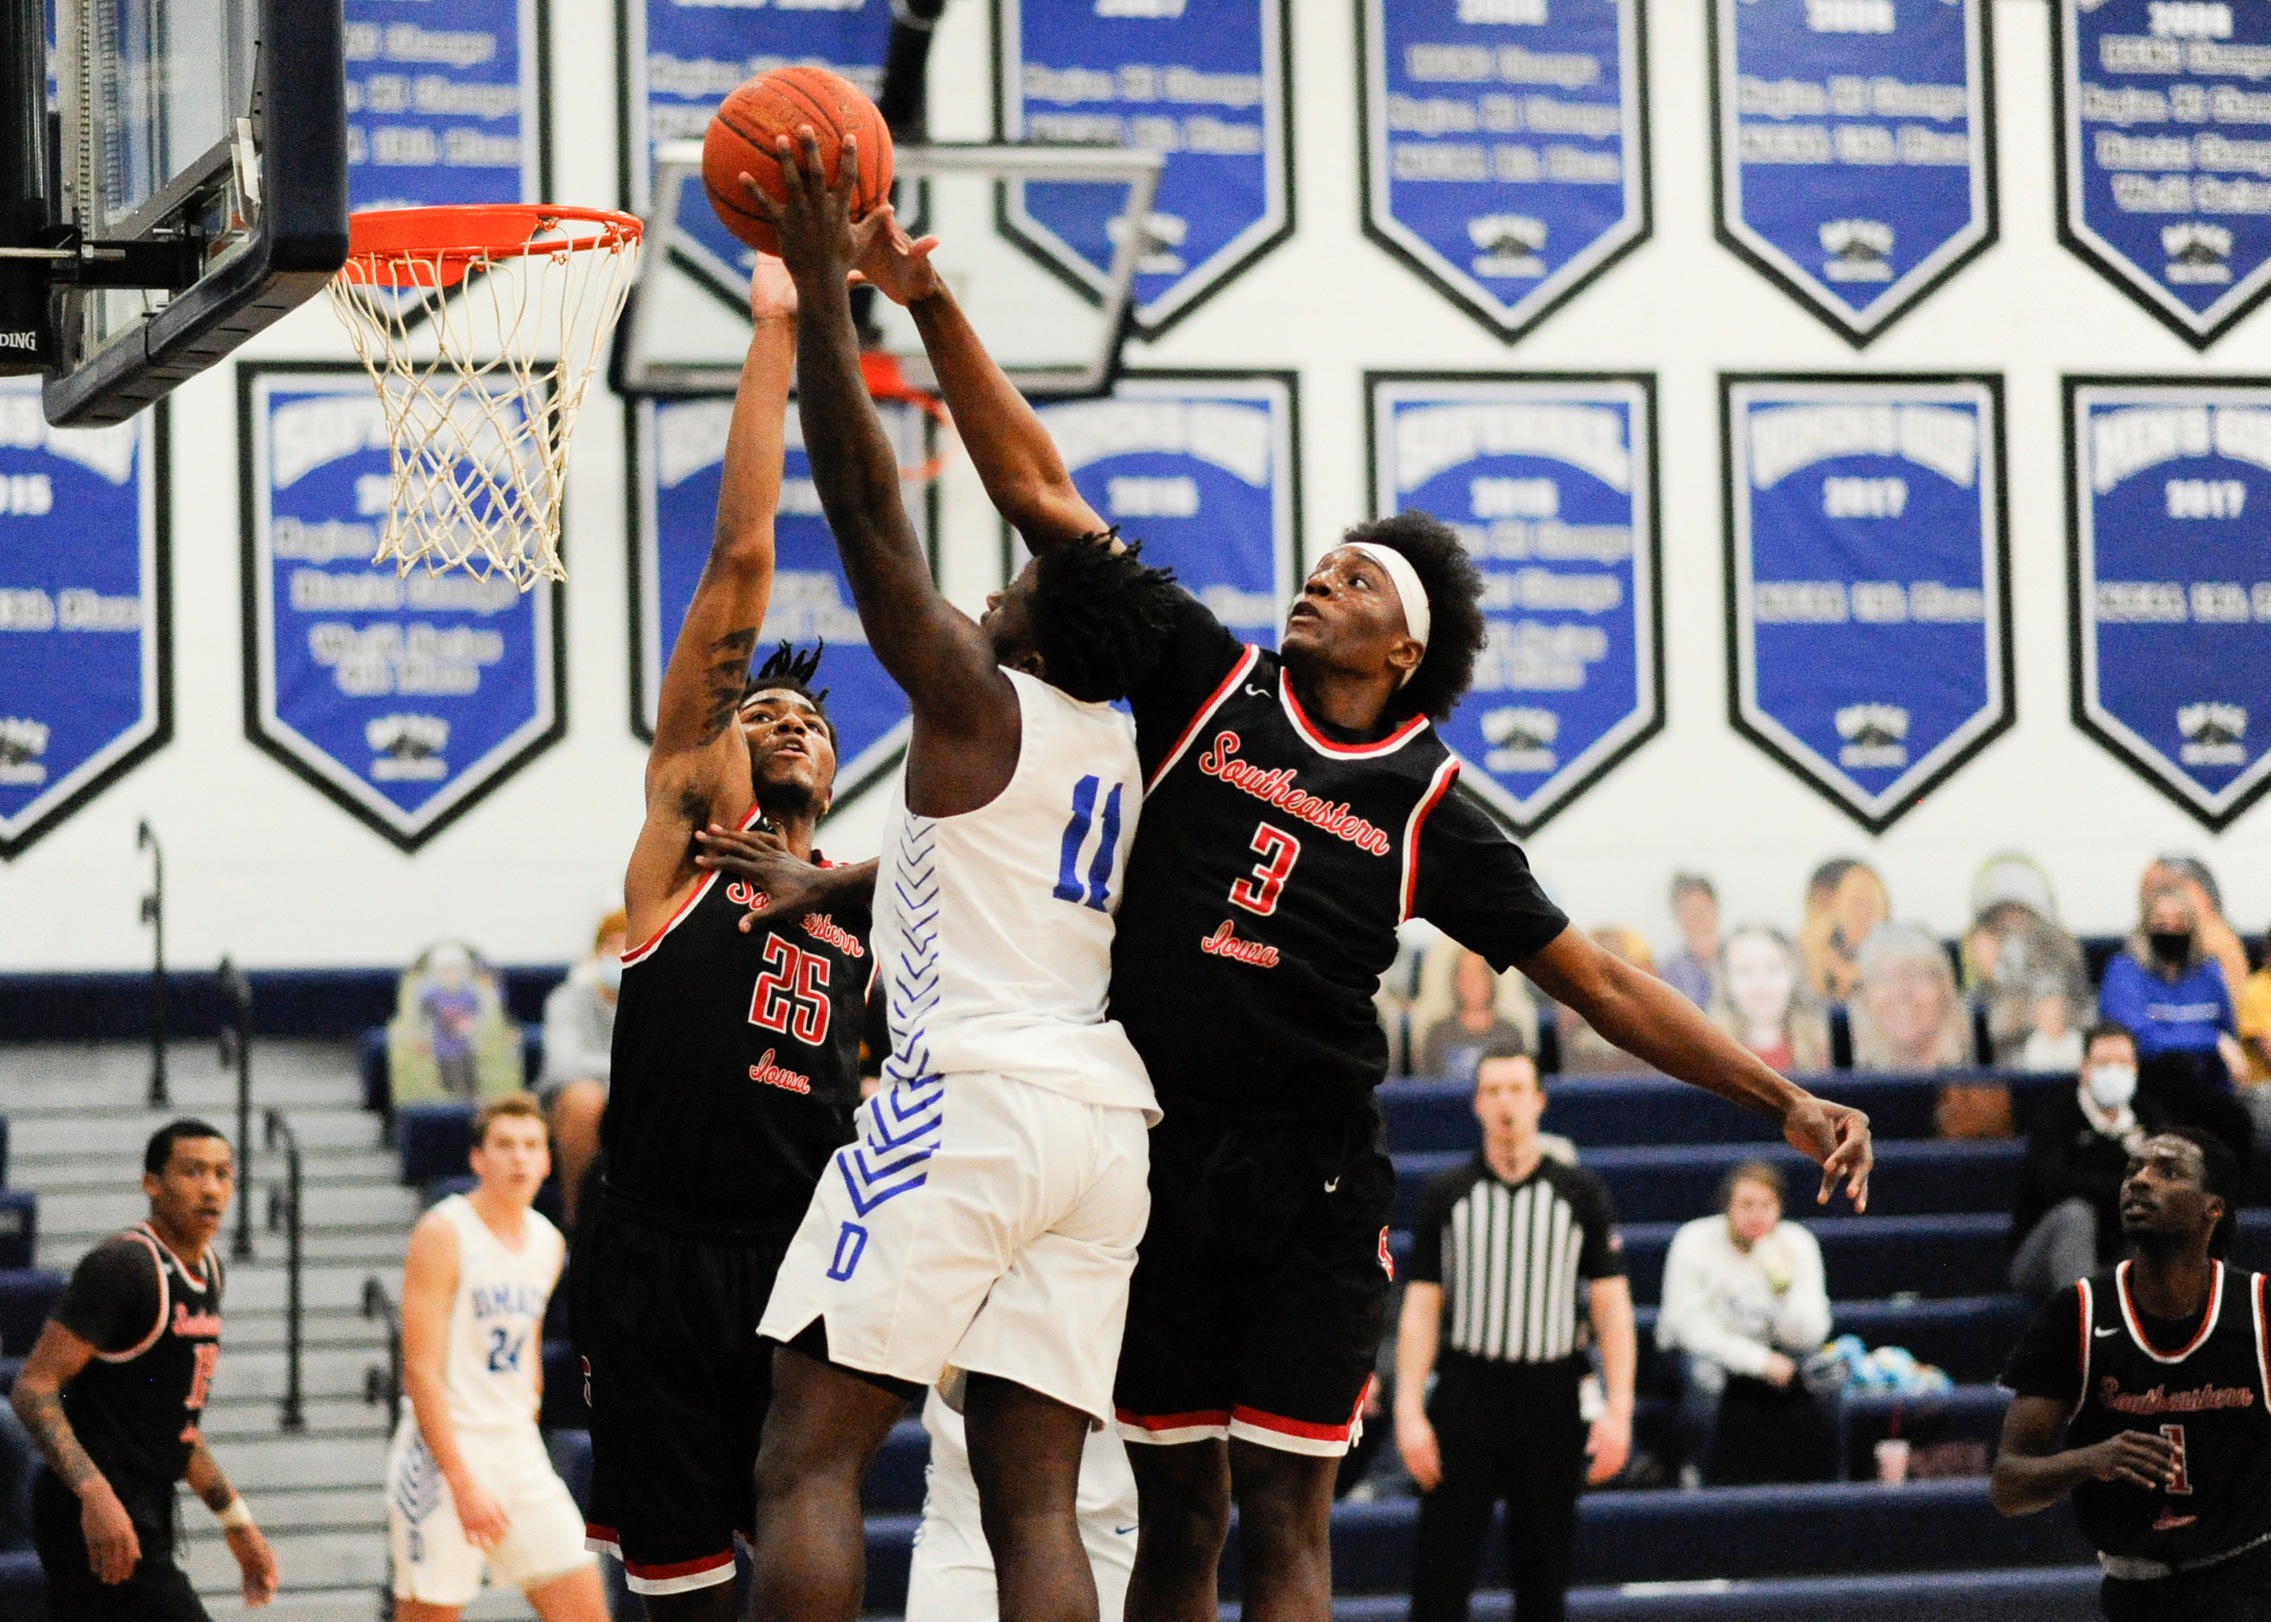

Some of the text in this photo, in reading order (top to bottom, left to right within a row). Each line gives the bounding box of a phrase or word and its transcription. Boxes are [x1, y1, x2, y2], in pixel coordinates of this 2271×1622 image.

[0, 331, 37, 351] DING
[1199, 731, 1390, 857] Southeastern
[1053, 774, 1123, 913] 11
[1228, 821, 1301, 917] 3
[1201, 919, 1279, 969] Iowa
[748, 932, 831, 1047] 25
[750, 1048, 811, 1095] Iowa
[826, 1220, 868, 1282] D
